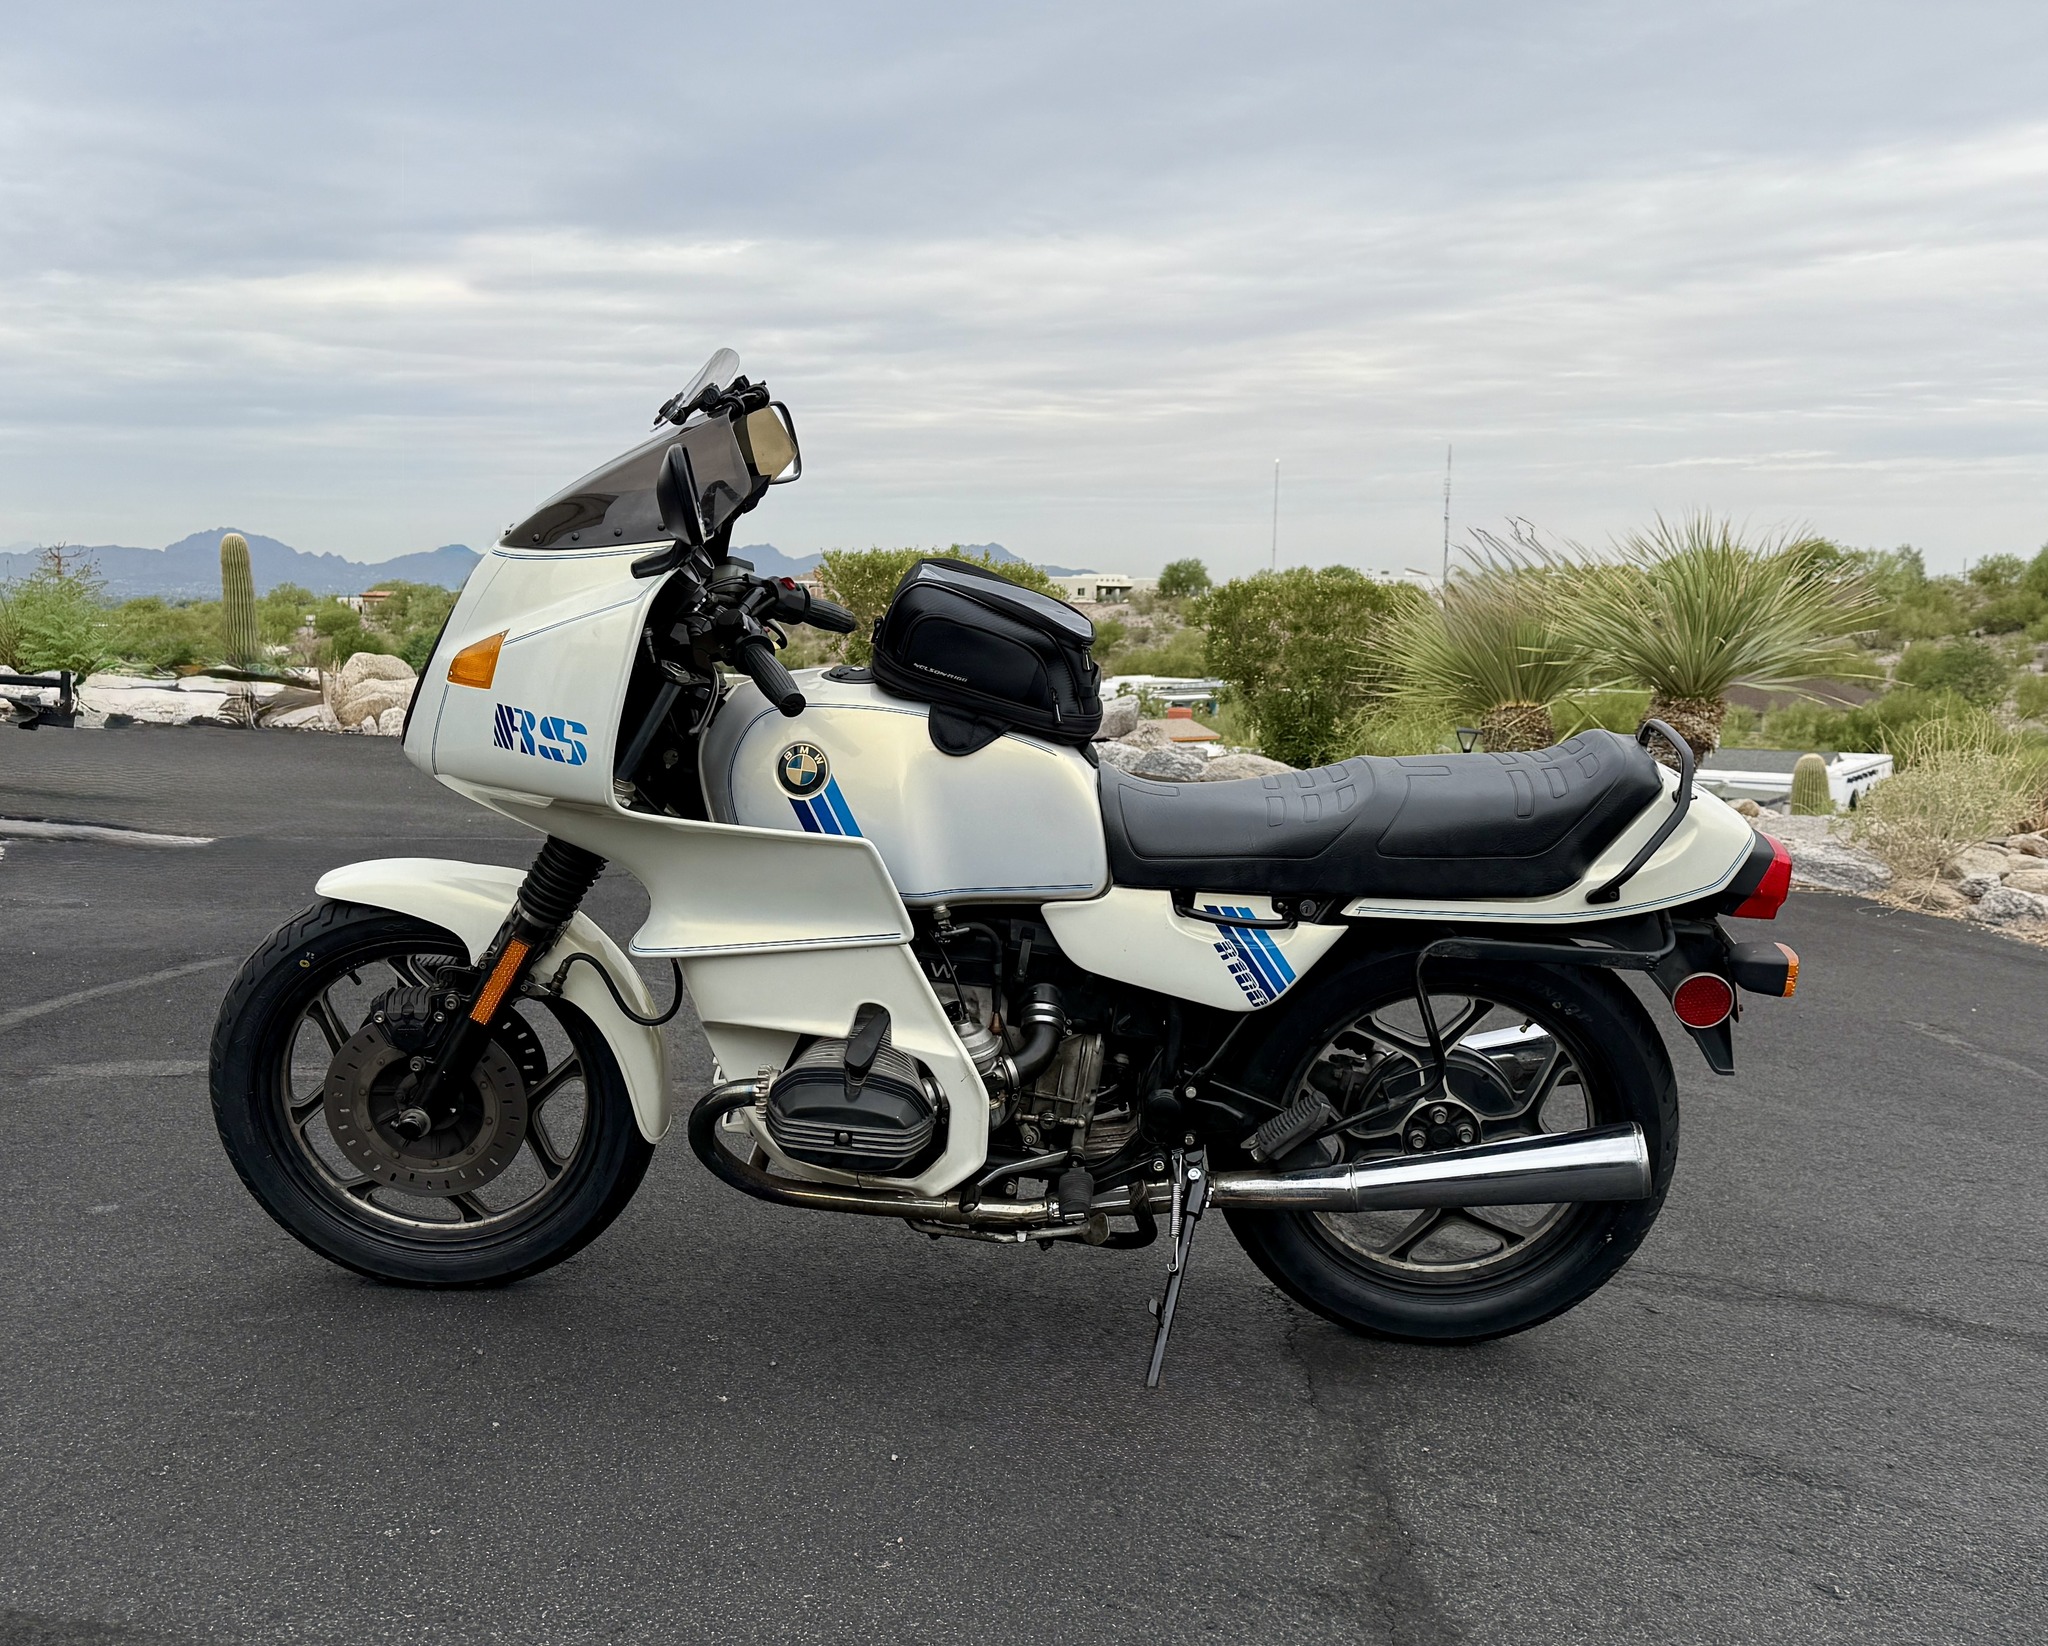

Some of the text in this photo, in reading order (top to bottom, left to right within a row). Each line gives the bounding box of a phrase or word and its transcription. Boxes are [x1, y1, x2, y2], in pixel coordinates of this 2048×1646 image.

[493, 702, 588, 766] RS
[783, 745, 824, 765] BMW
[1213, 939, 1270, 1008] R100
